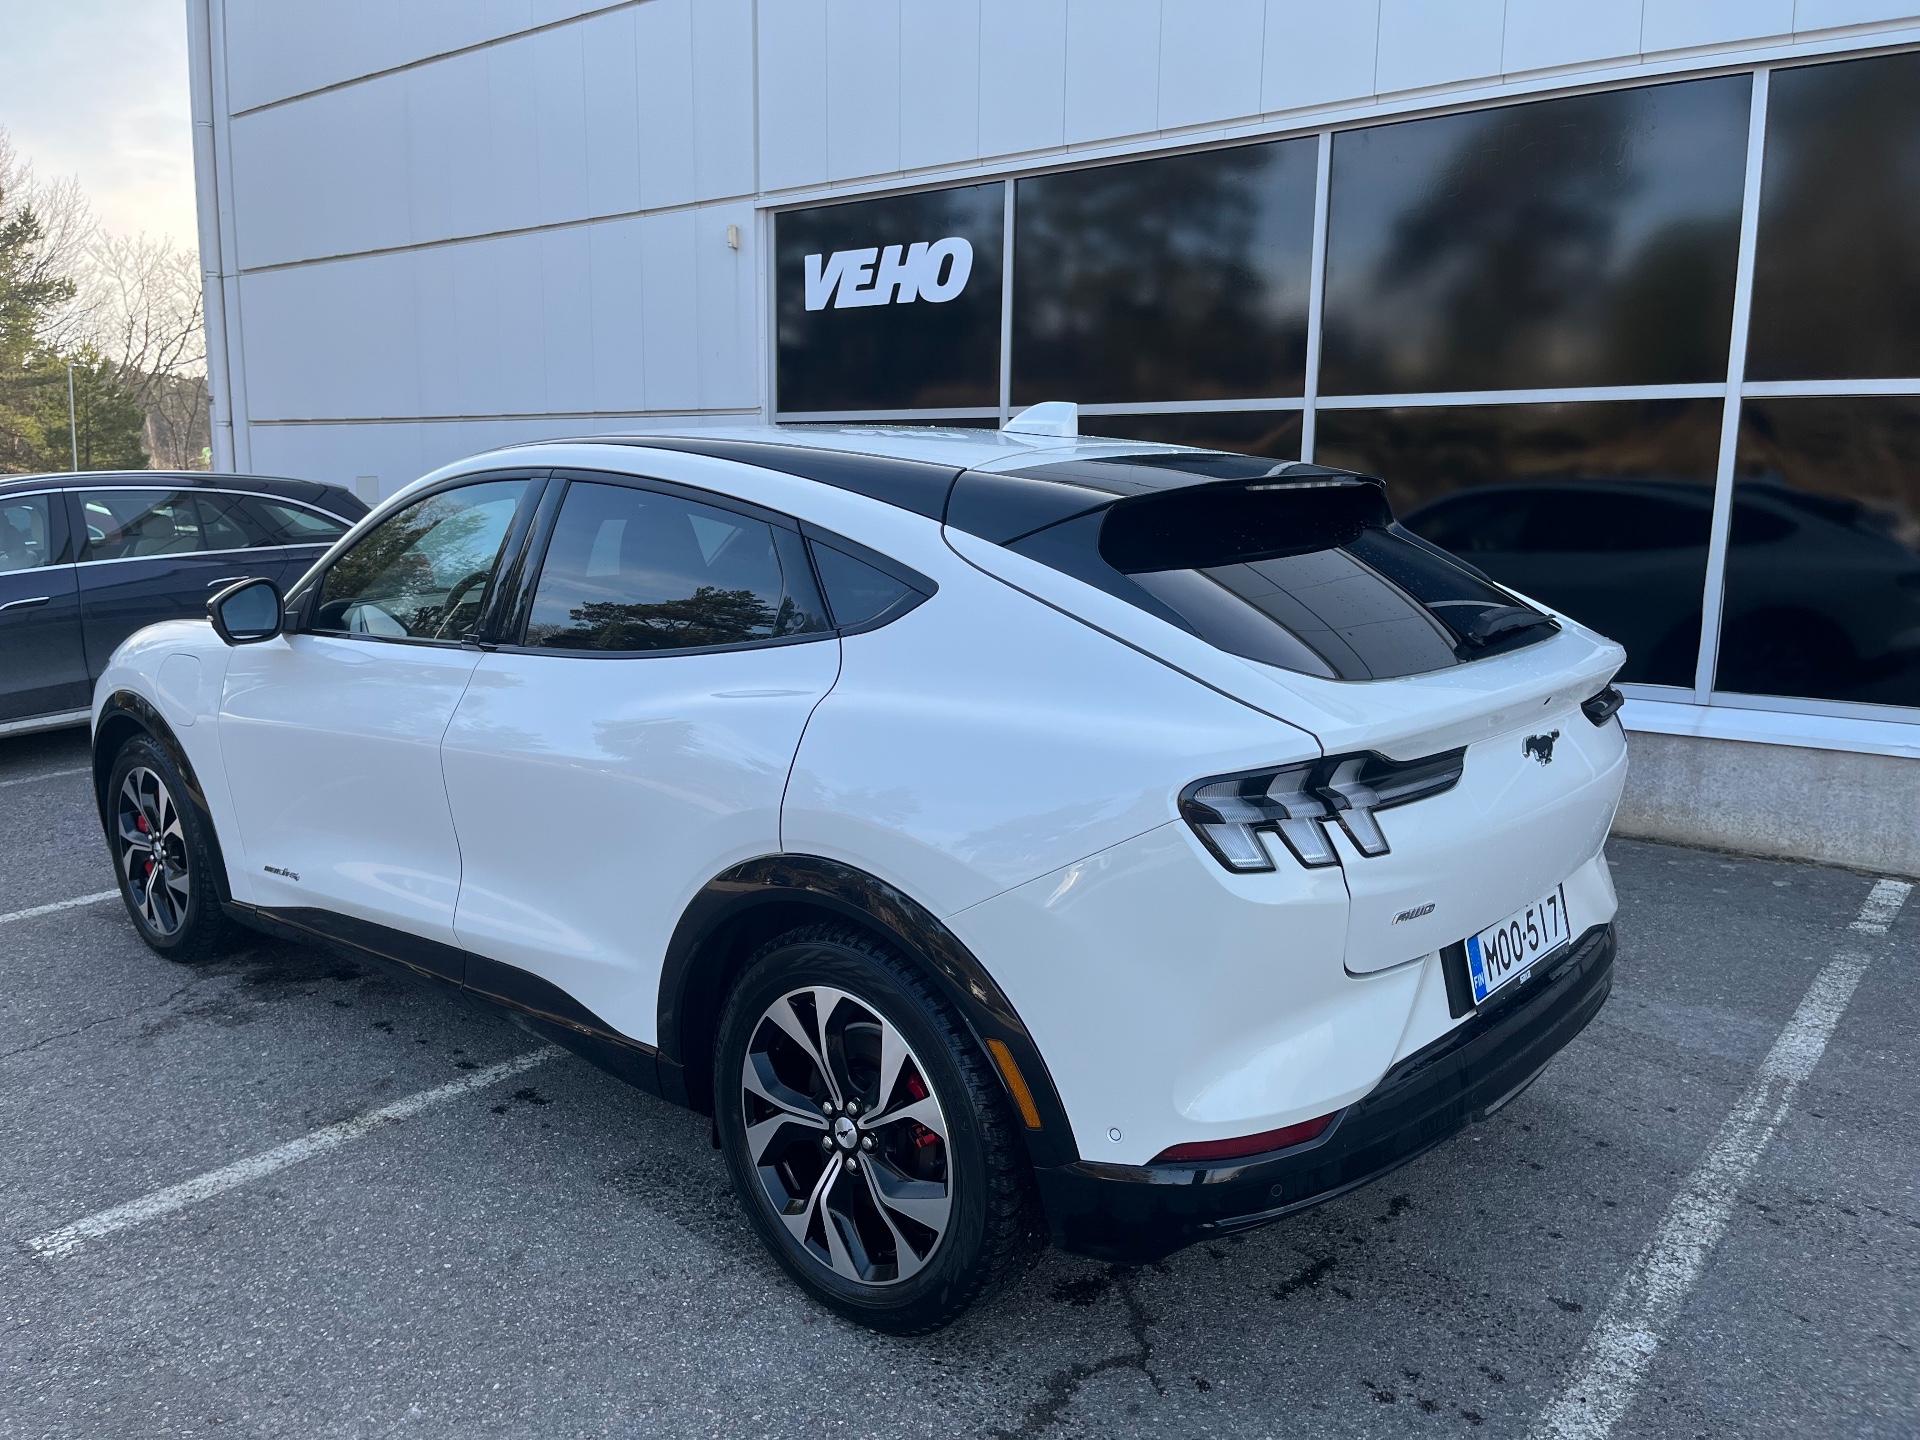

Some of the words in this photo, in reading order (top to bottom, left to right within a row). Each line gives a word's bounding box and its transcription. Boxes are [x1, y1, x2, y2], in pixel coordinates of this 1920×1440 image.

[804, 237, 973, 312] VEHO
[1483, 895, 1558, 982] MOO-517
[1473, 972, 1485, 990] FIN
